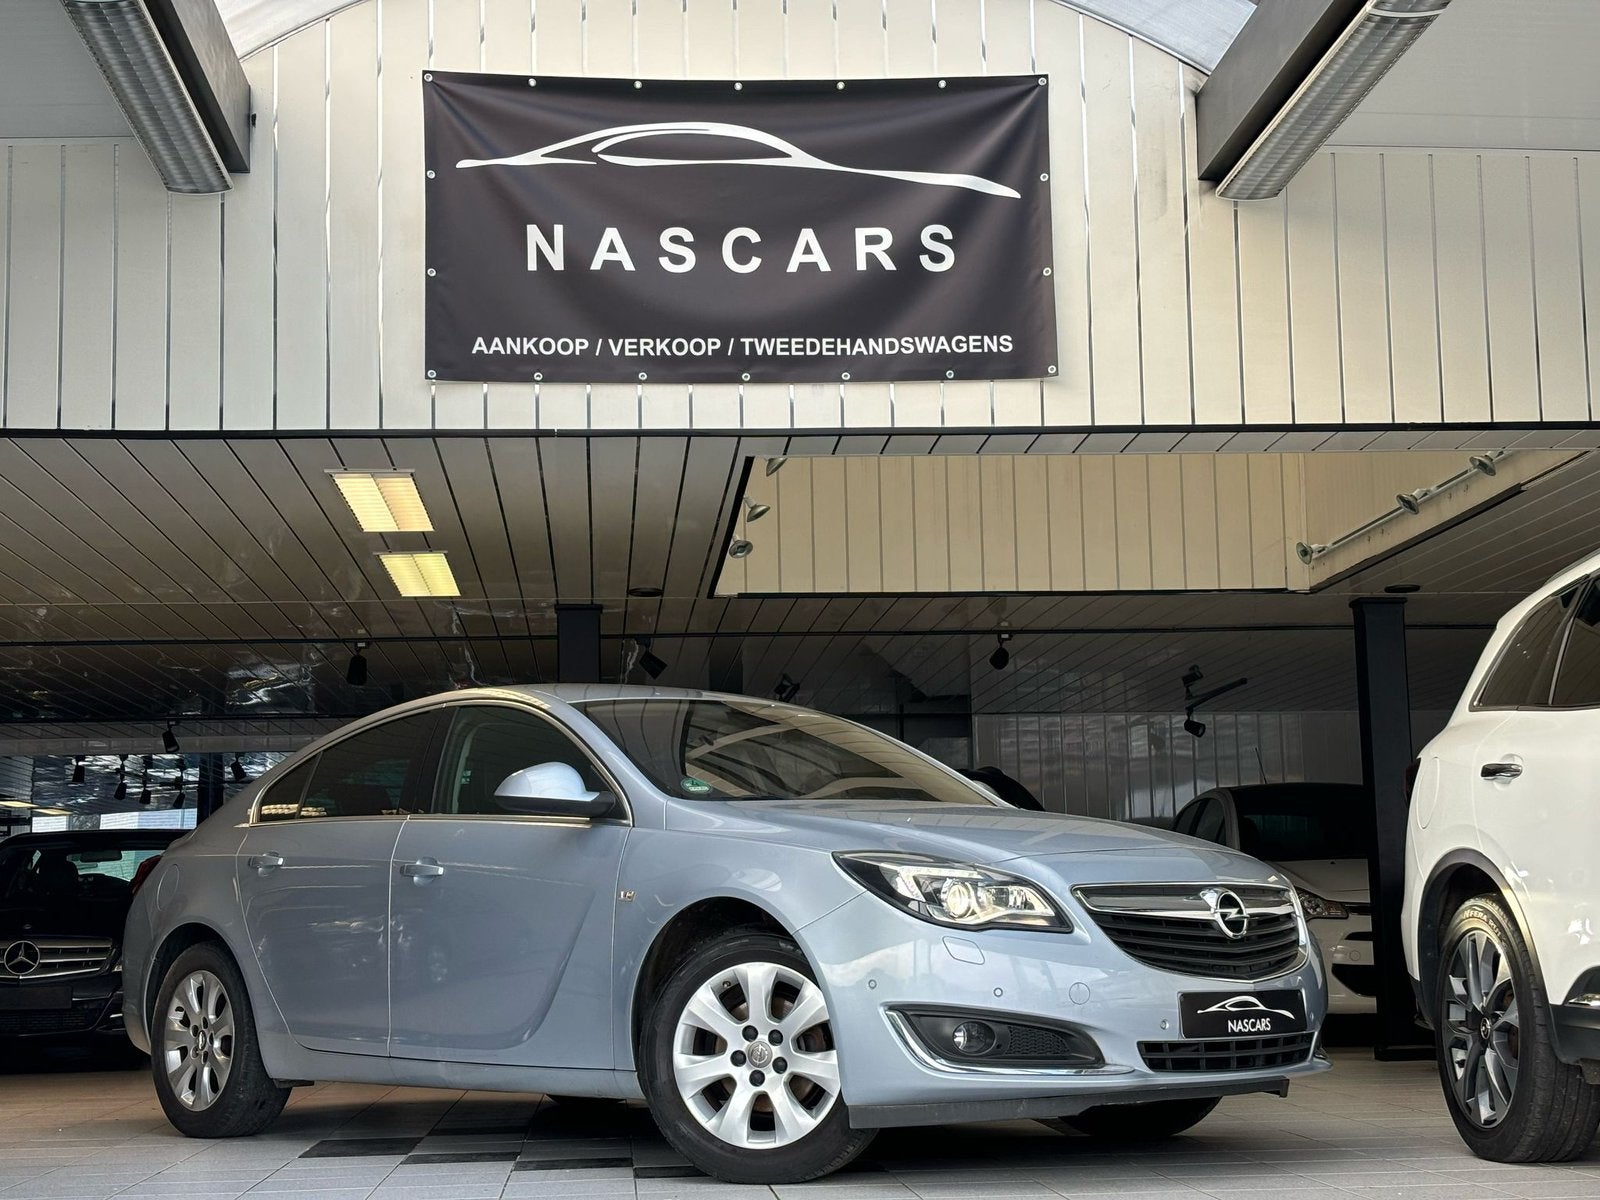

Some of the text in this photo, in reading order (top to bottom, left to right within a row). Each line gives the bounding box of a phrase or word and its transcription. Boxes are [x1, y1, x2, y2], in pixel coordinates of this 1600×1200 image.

[527, 223, 956, 274] NASCARS
[472, 334, 1014, 356] AANKOOP / VERKOOP / TWEEDEHANDSWAGENS
[1227, 1018, 1271, 1033] NASCARS
